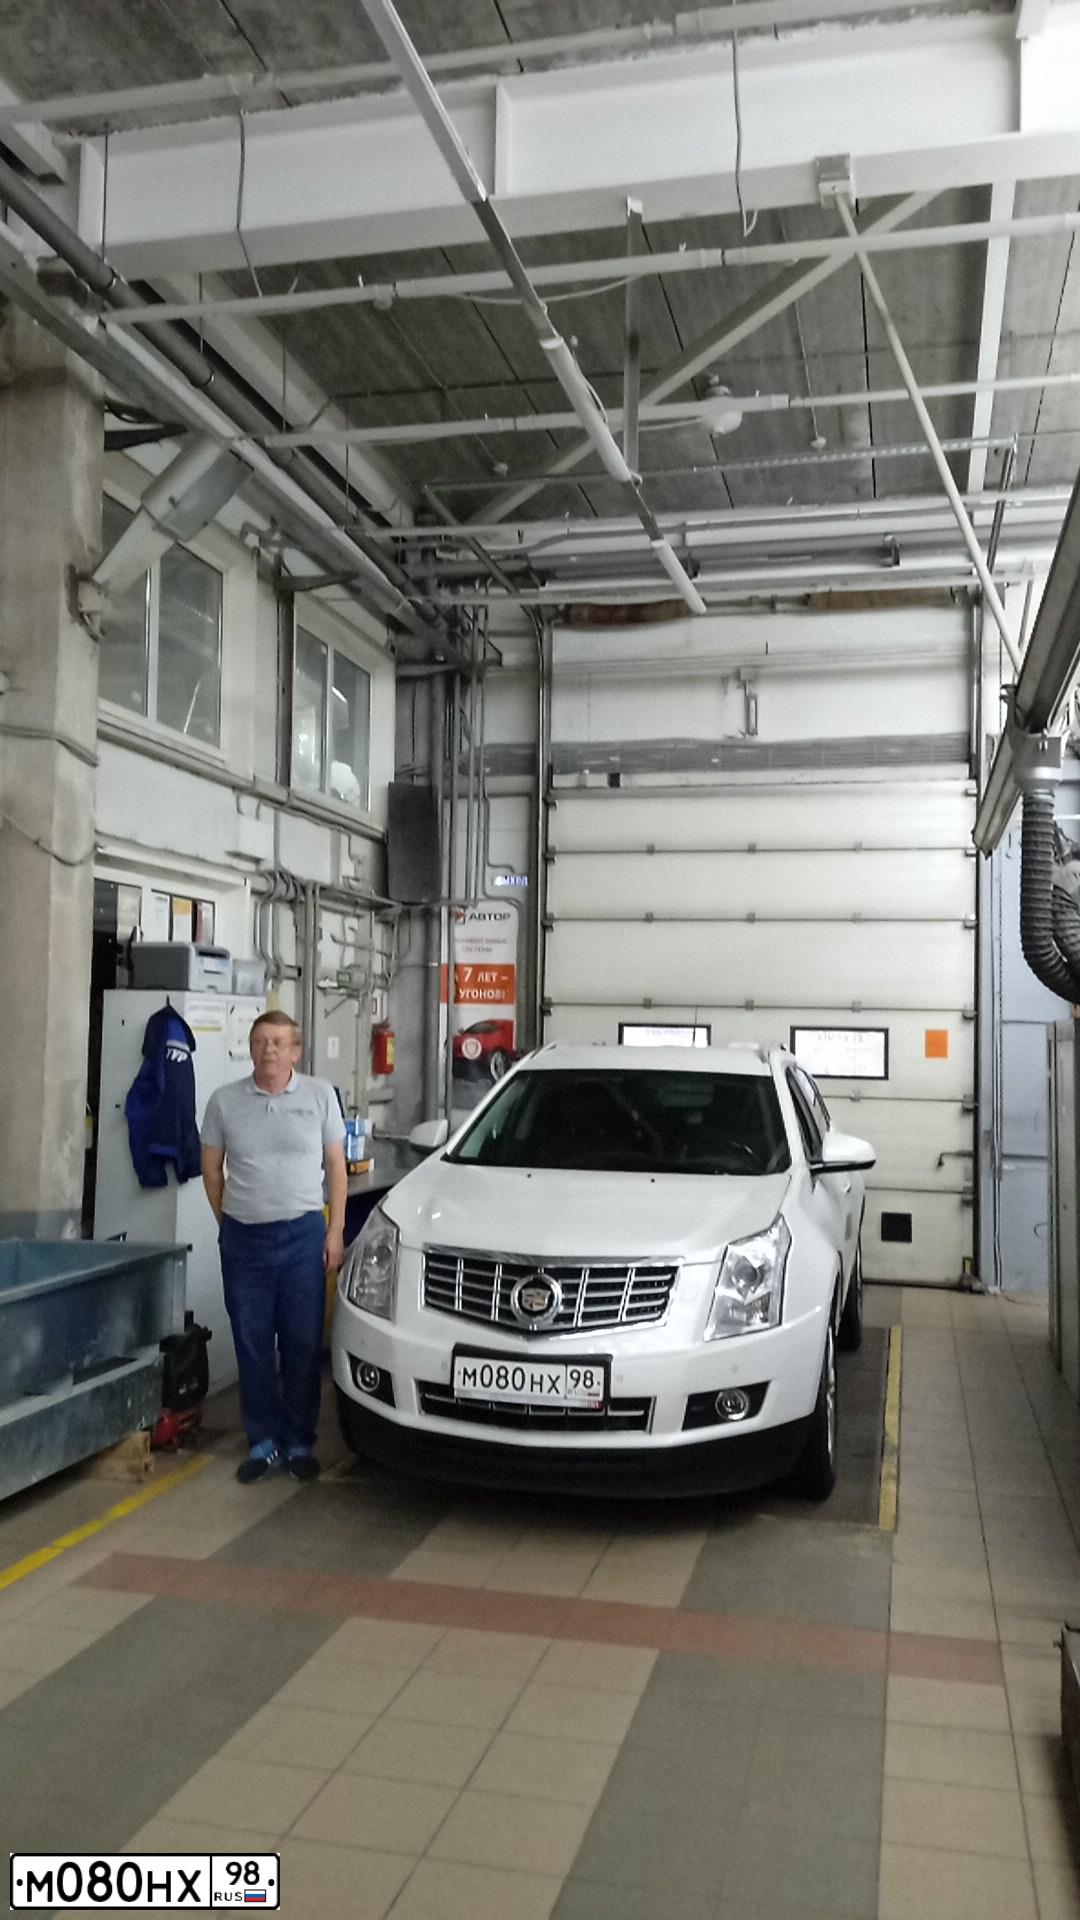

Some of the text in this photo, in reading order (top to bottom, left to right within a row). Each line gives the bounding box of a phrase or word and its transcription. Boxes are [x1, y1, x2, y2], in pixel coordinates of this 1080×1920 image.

[463, 966, 473, 983] 7
[477, 971, 498, 982] ЛЕТ
[569, 1369, 594, 1389] 98
